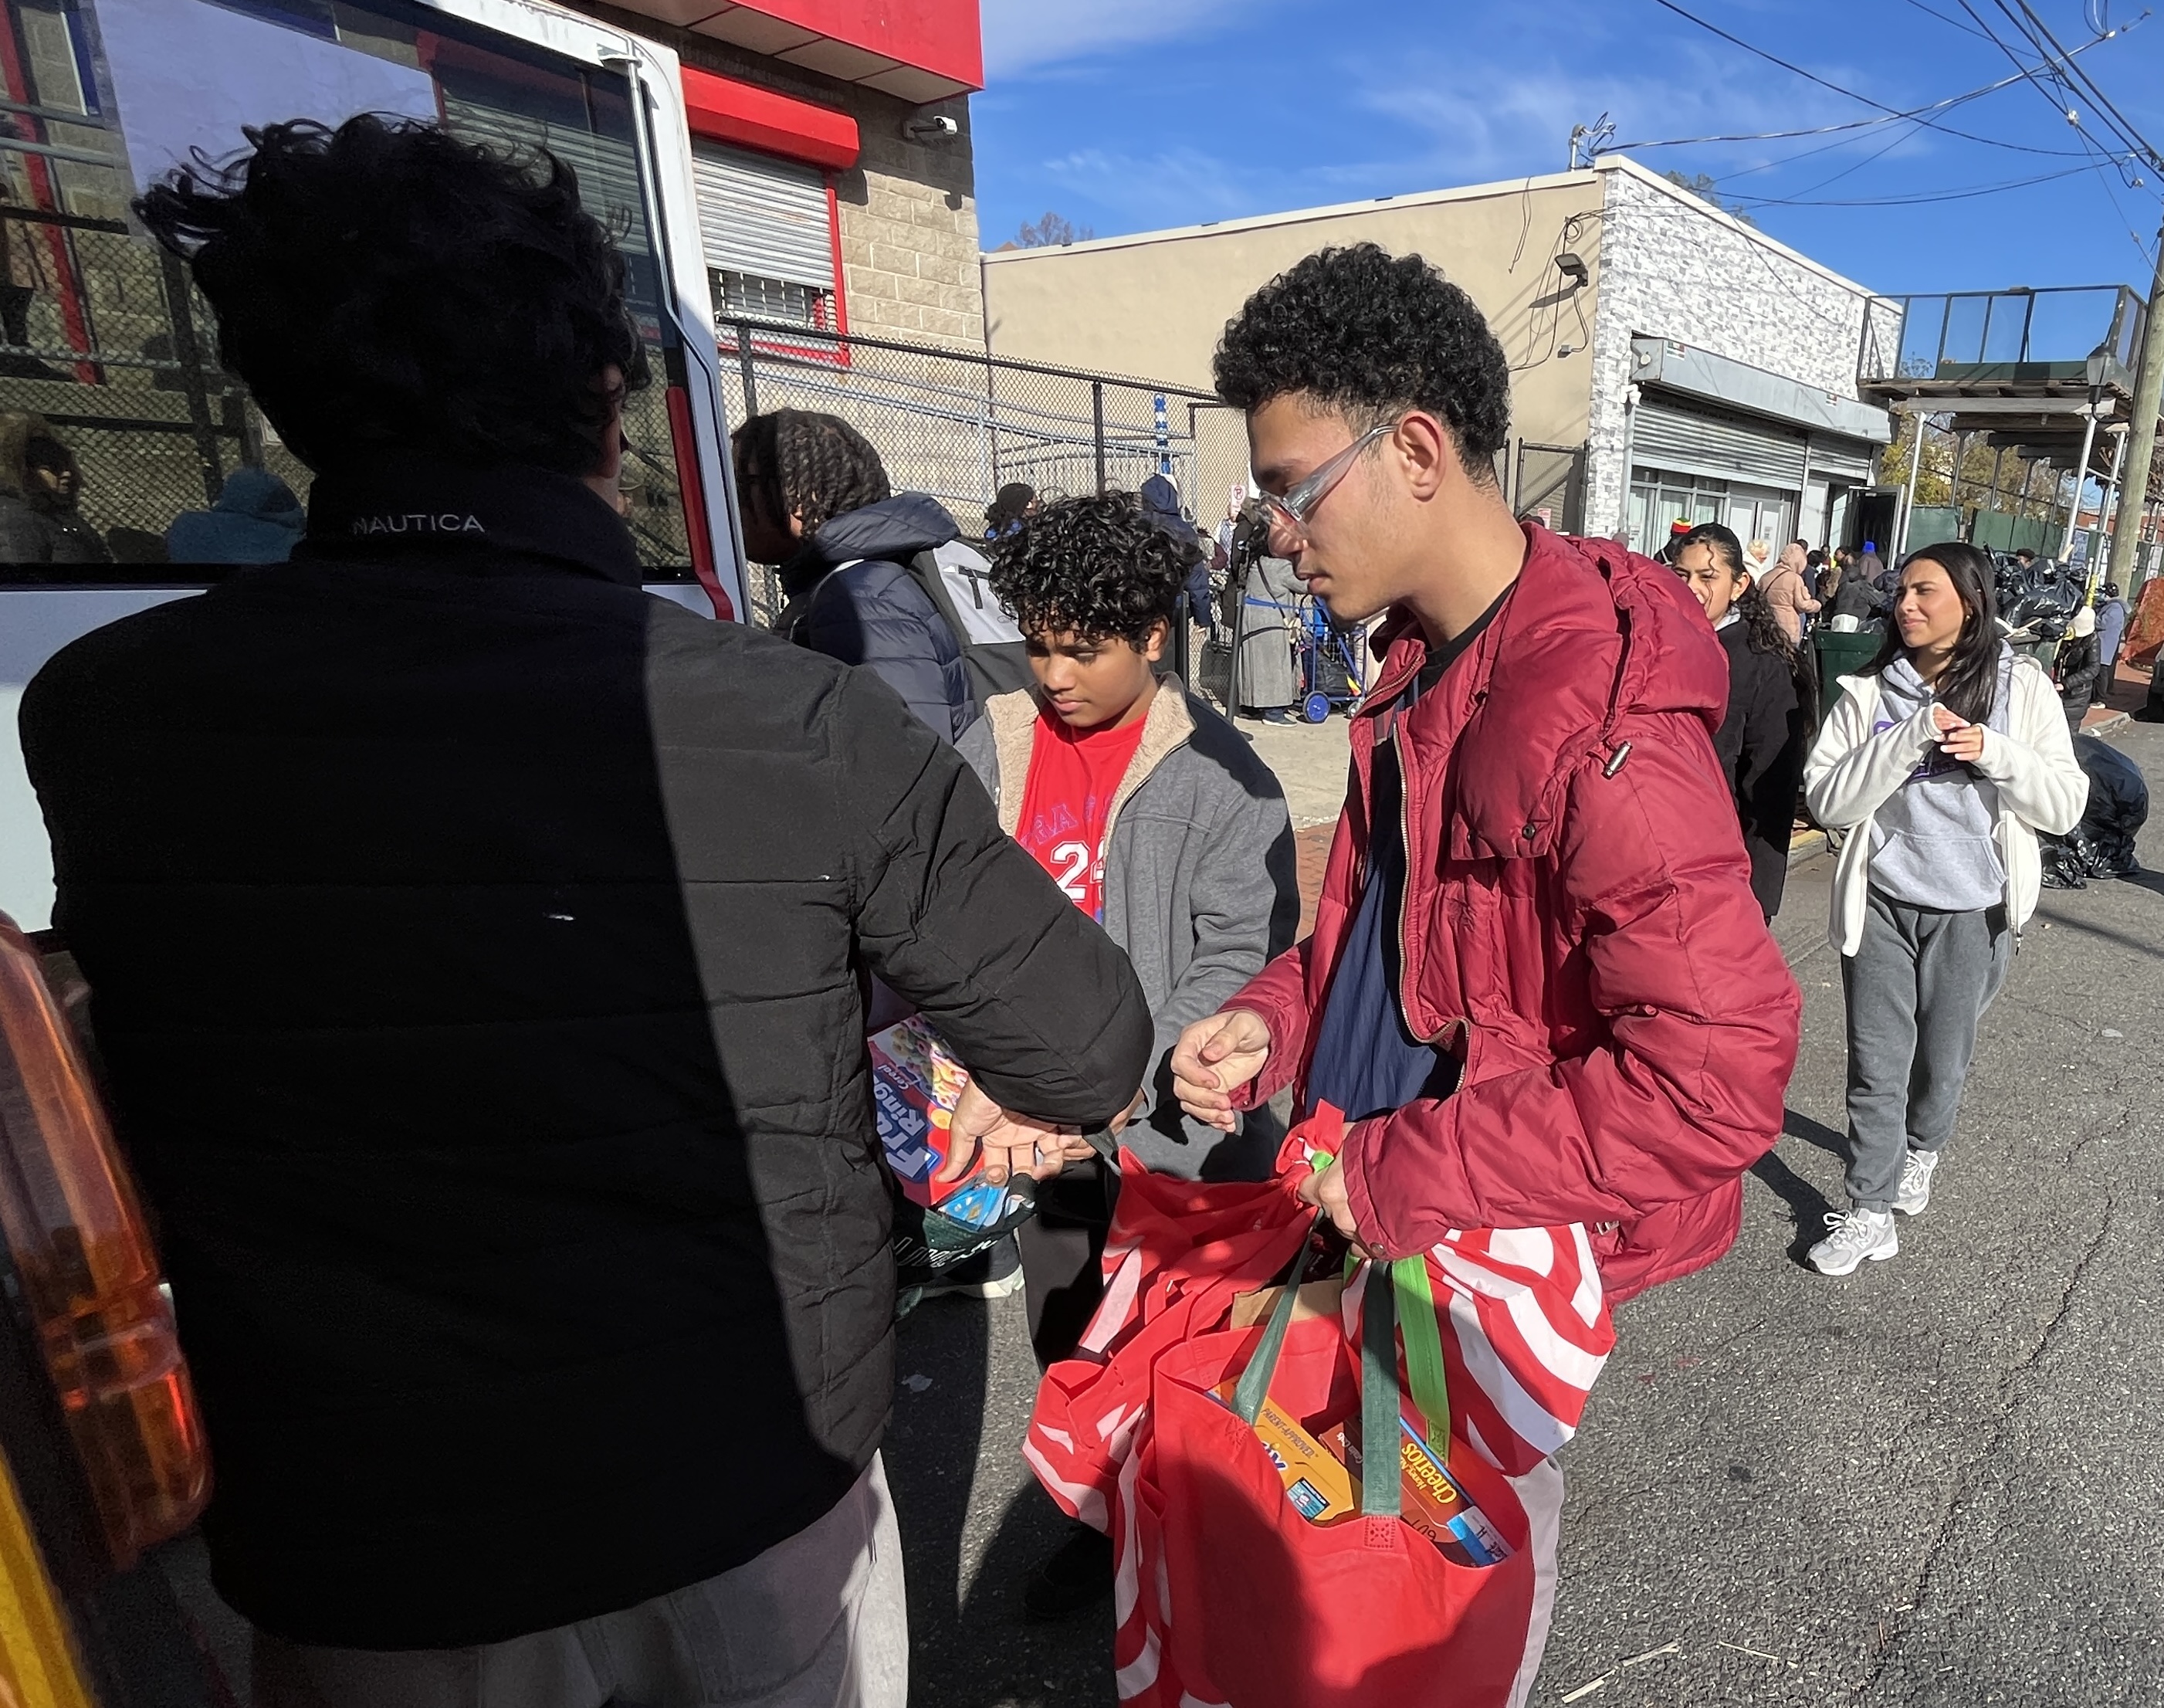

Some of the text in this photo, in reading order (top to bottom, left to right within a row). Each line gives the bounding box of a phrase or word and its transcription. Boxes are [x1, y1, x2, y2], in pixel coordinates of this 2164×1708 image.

[352, 513, 486, 535] NAUTICA
[878, 1064, 910, 1090] Cereal
[876, 1111, 933, 1178] Fru
[1400, 1442, 1458, 1504] Cheerios
[1407, 1466, 1428, 1491] Honey
